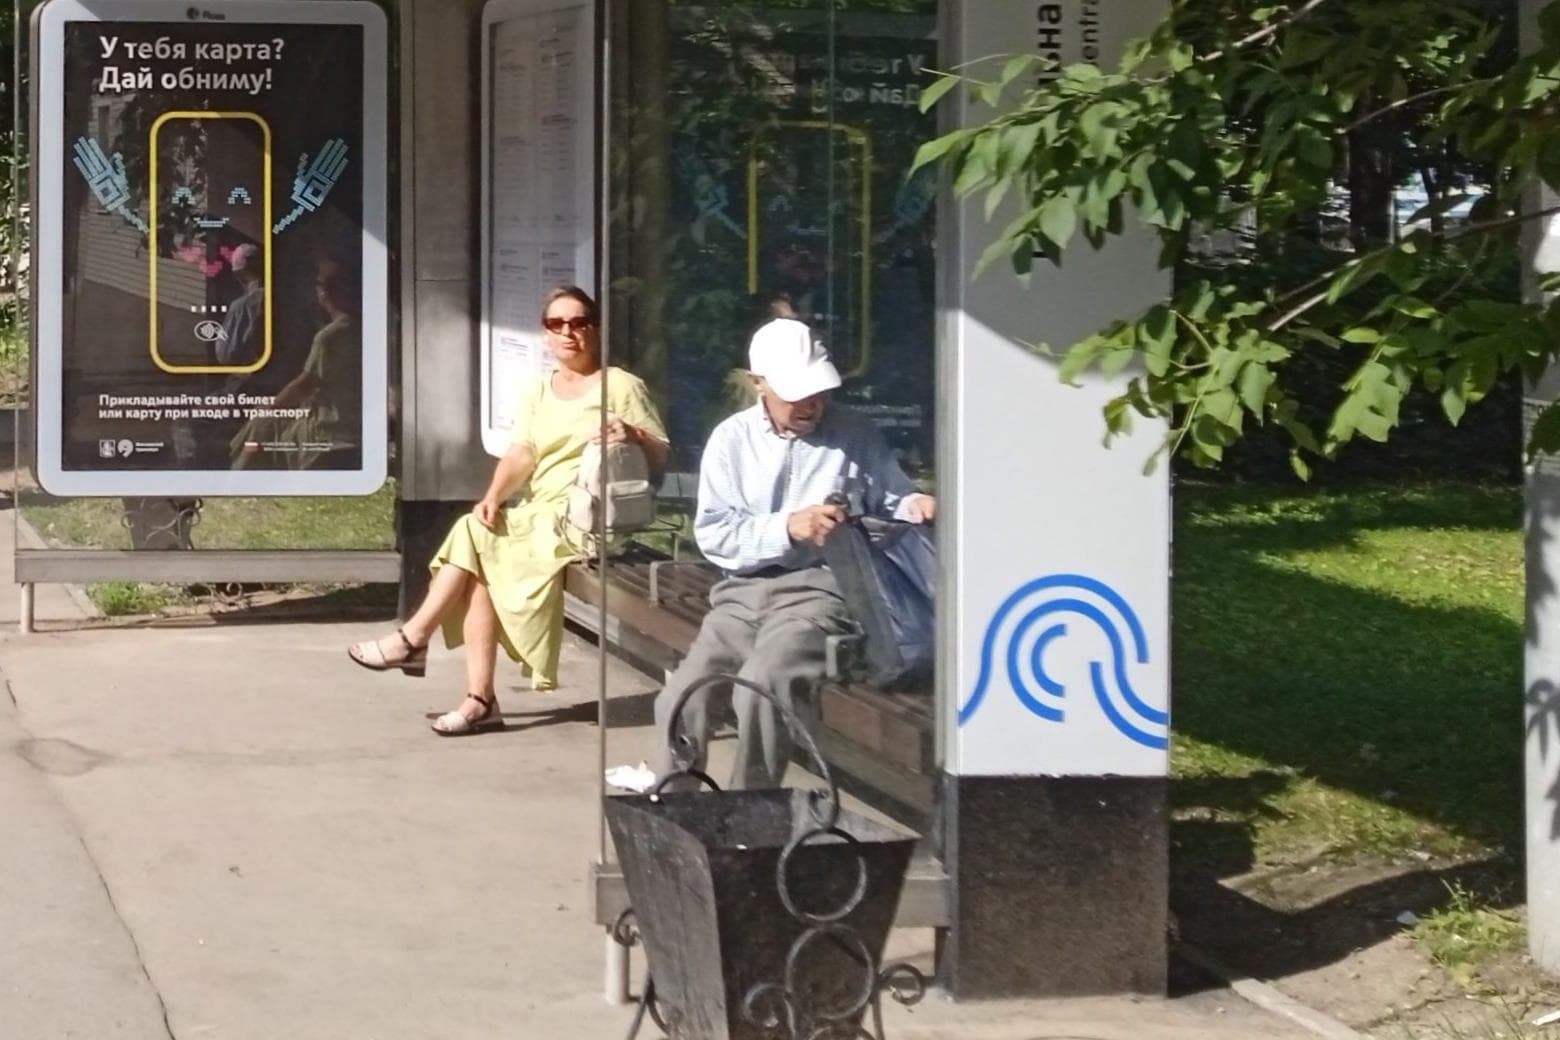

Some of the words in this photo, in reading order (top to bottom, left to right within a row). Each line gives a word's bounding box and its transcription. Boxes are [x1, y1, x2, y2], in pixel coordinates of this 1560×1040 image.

[99, 36, 119, 59] У
[124, 36, 186, 59] тебя
[195, 38, 285, 65] карта?
[99, 66, 153, 92] Дай
[161, 67, 272, 95] обниму!
[99, 394, 201, 407] Прикладывайте
[204, 394, 235, 405] свой
[238, 394, 276, 405] билет
[99, 409, 122, 418] или
[125, 410, 161, 421] карту
[165, 410, 189, 420] при
[192, 409, 229, 420] входе
[233, 410, 240, 418] в
[243, 409, 310, 421] транспорт
